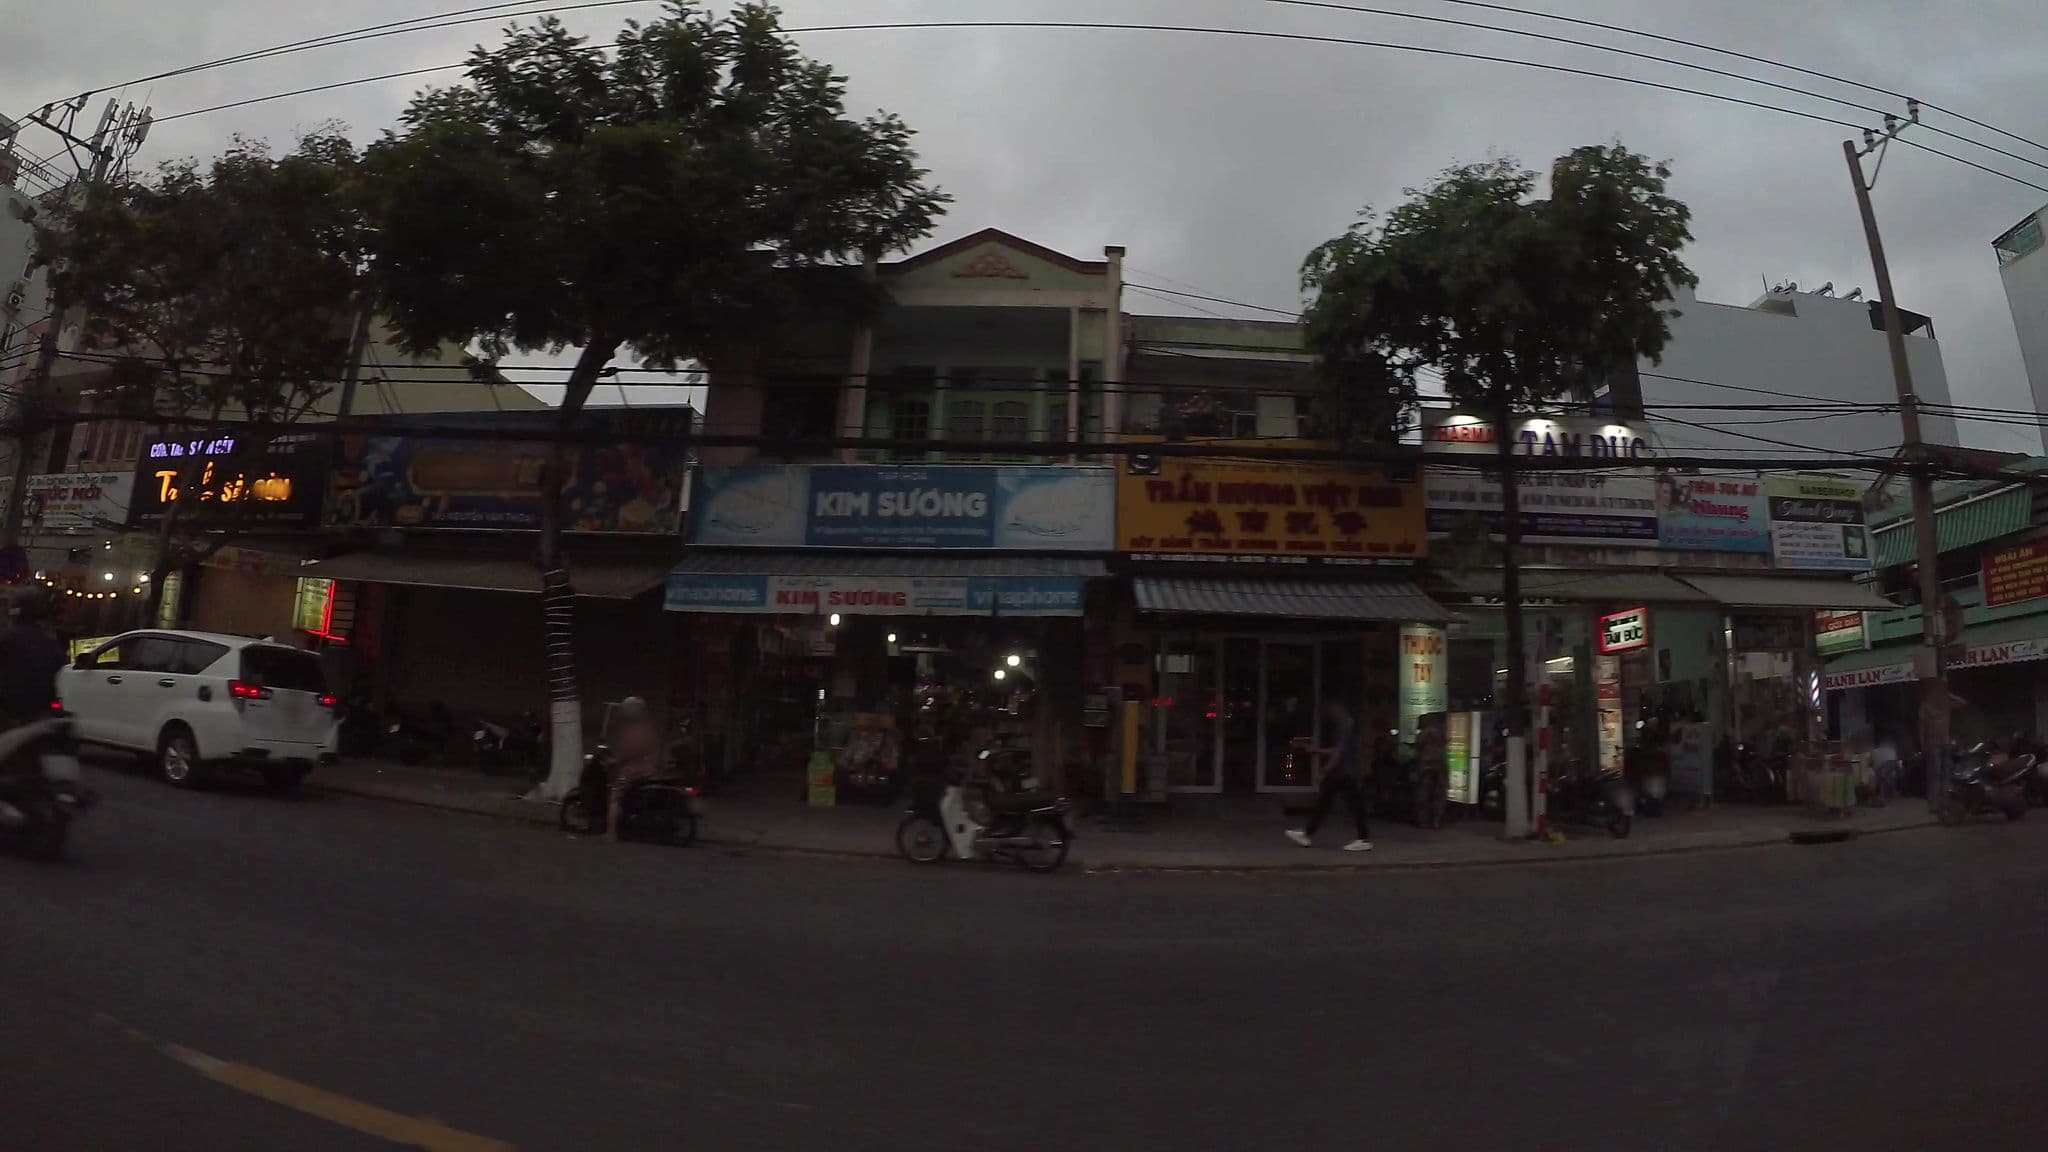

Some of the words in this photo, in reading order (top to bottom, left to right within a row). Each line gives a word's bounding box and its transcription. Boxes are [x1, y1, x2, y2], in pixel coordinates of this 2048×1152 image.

[815, 491, 870, 517] KIM
[776, 590, 818, 605] KIM
[1981, 646, 2010, 663] LAN
